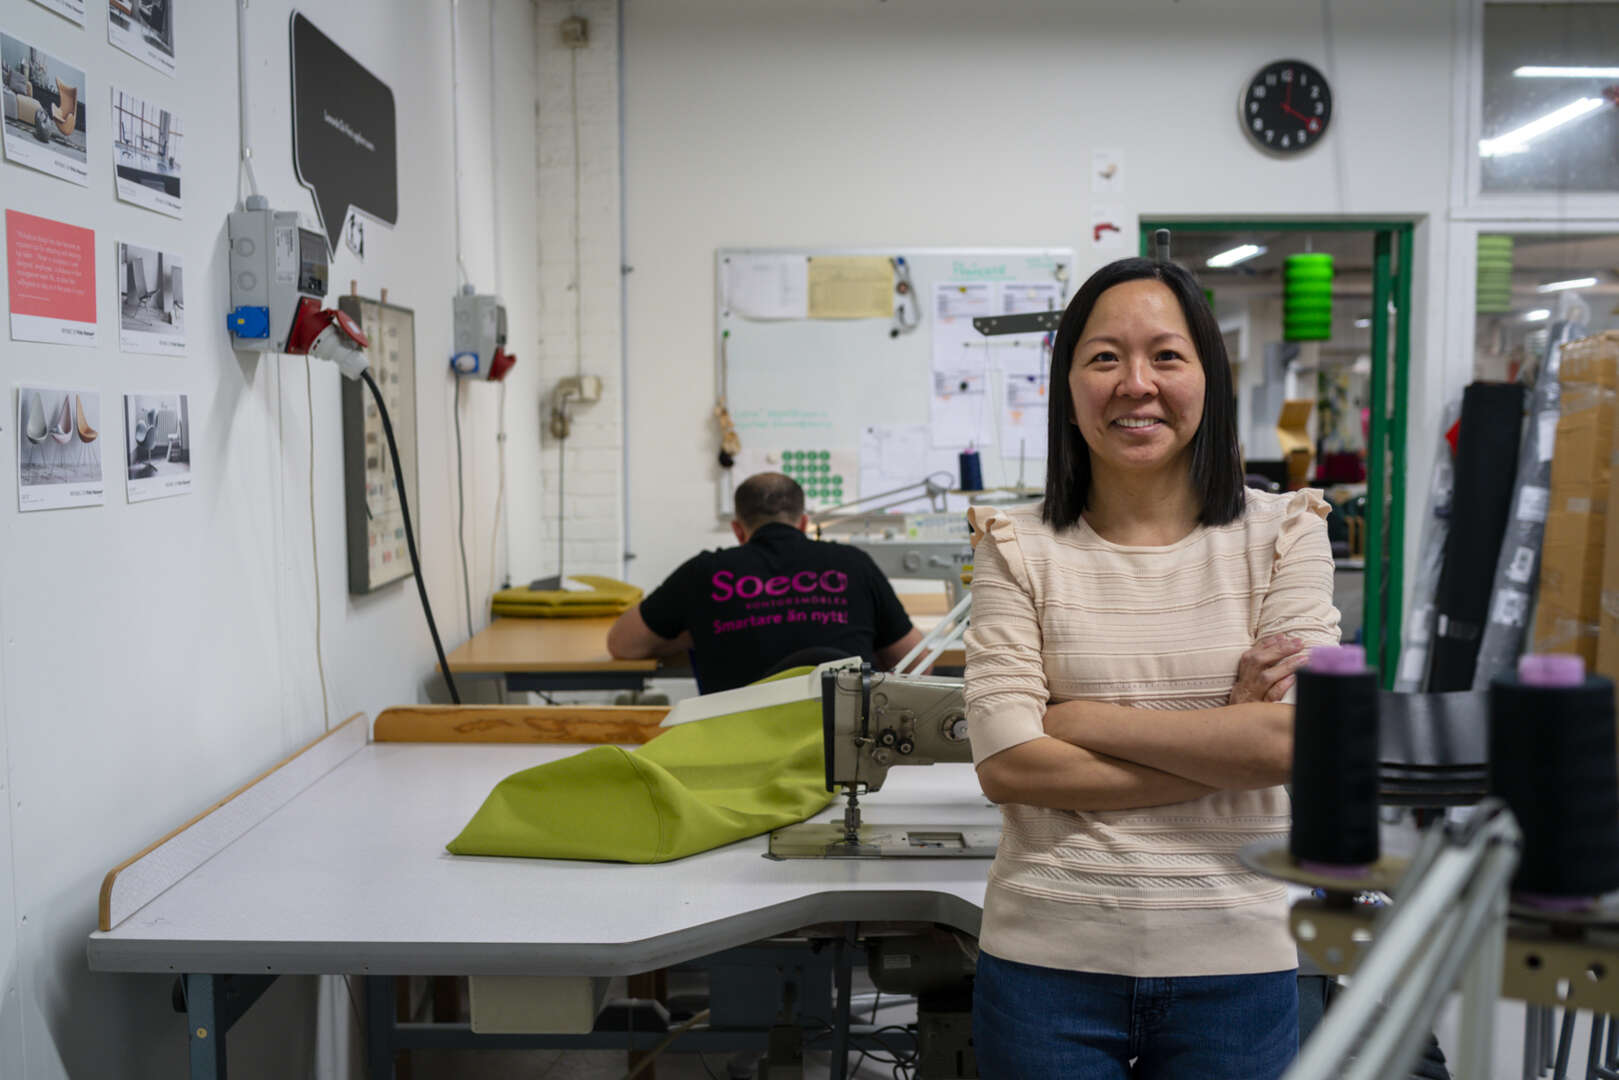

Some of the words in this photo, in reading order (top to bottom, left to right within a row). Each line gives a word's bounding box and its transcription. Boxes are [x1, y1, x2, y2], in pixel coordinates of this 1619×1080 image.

[1254, 86, 1266, 98] 10
[1310, 86, 1320, 98] 2
[1250, 102, 1259, 114] 9
[1314, 102, 1324, 114] 3
[1254, 118, 1262, 130] 8
[1265, 130, 1274, 142] 7
[1282, 134, 1290, 147] 6
[1298, 130, 1306, 142] 5
[712, 570, 848, 601] Soeco
[713, 613, 782, 635] Smartare
[787, 608, 807, 623] än
